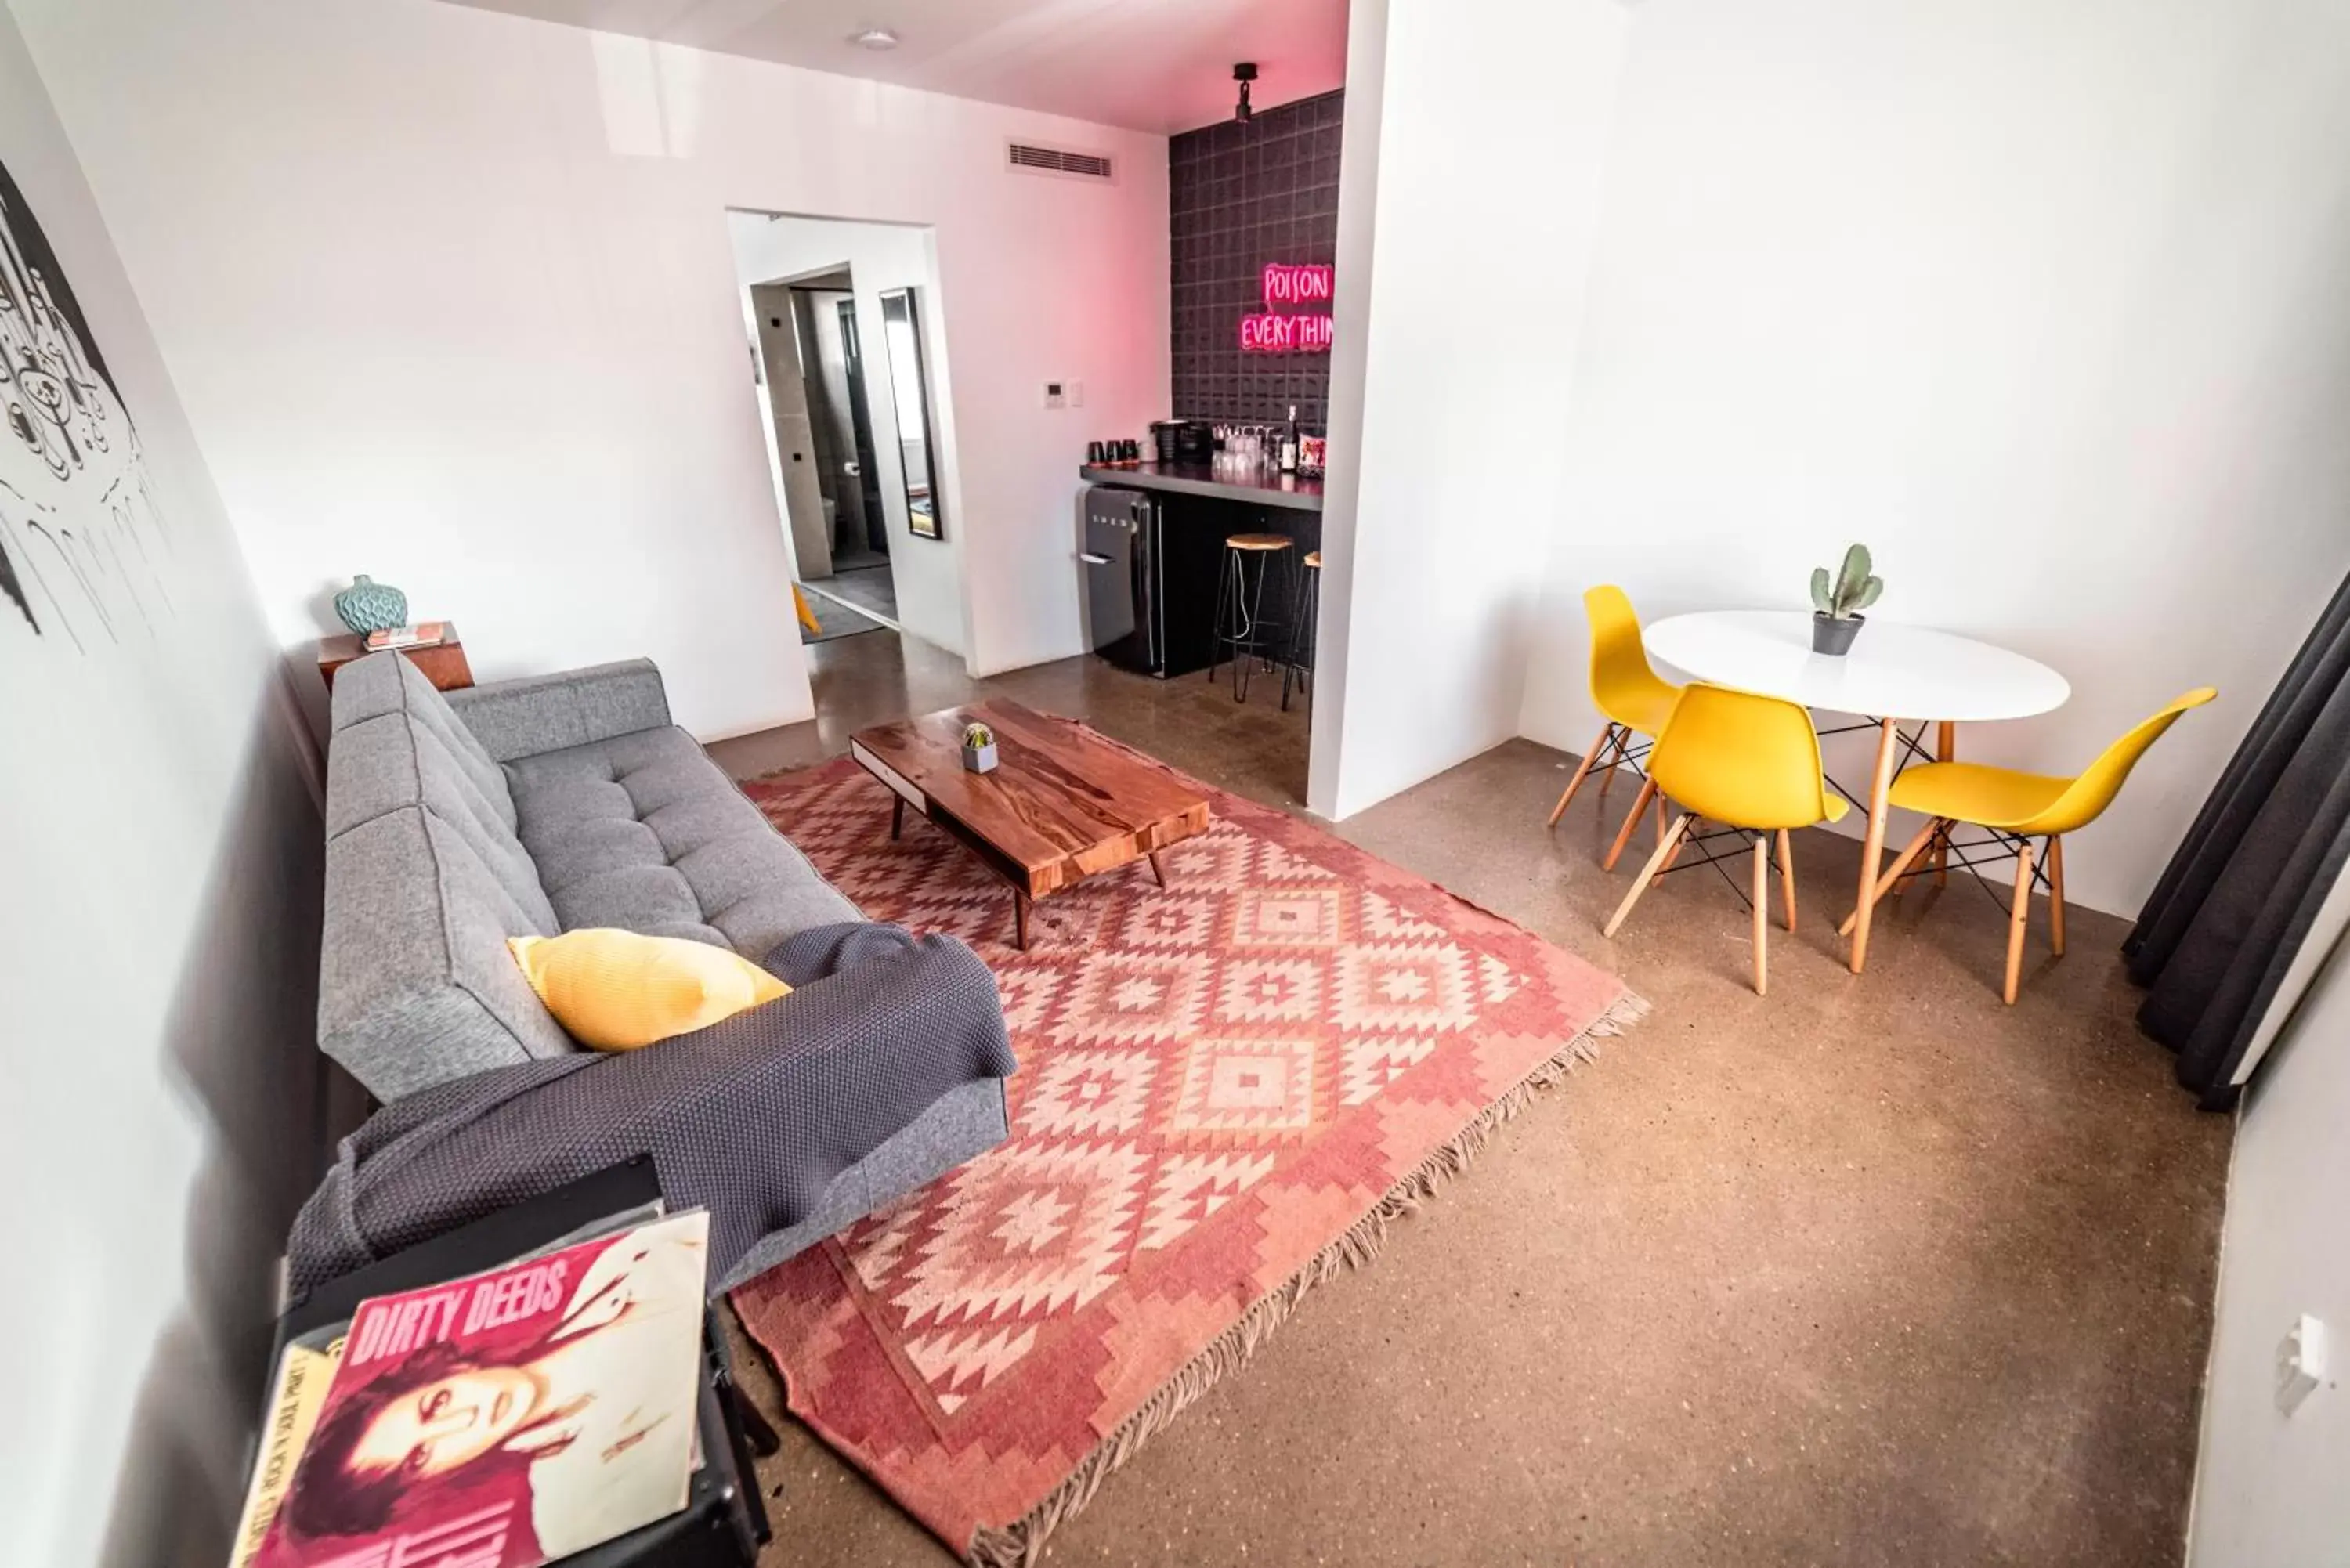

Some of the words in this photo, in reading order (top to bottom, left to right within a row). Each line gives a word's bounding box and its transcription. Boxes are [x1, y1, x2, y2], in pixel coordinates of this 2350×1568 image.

[1265, 269, 1329, 304] POISON
[349, 1288, 468, 1366] DIRTY
[461, 1259, 568, 1336] DEEDS
